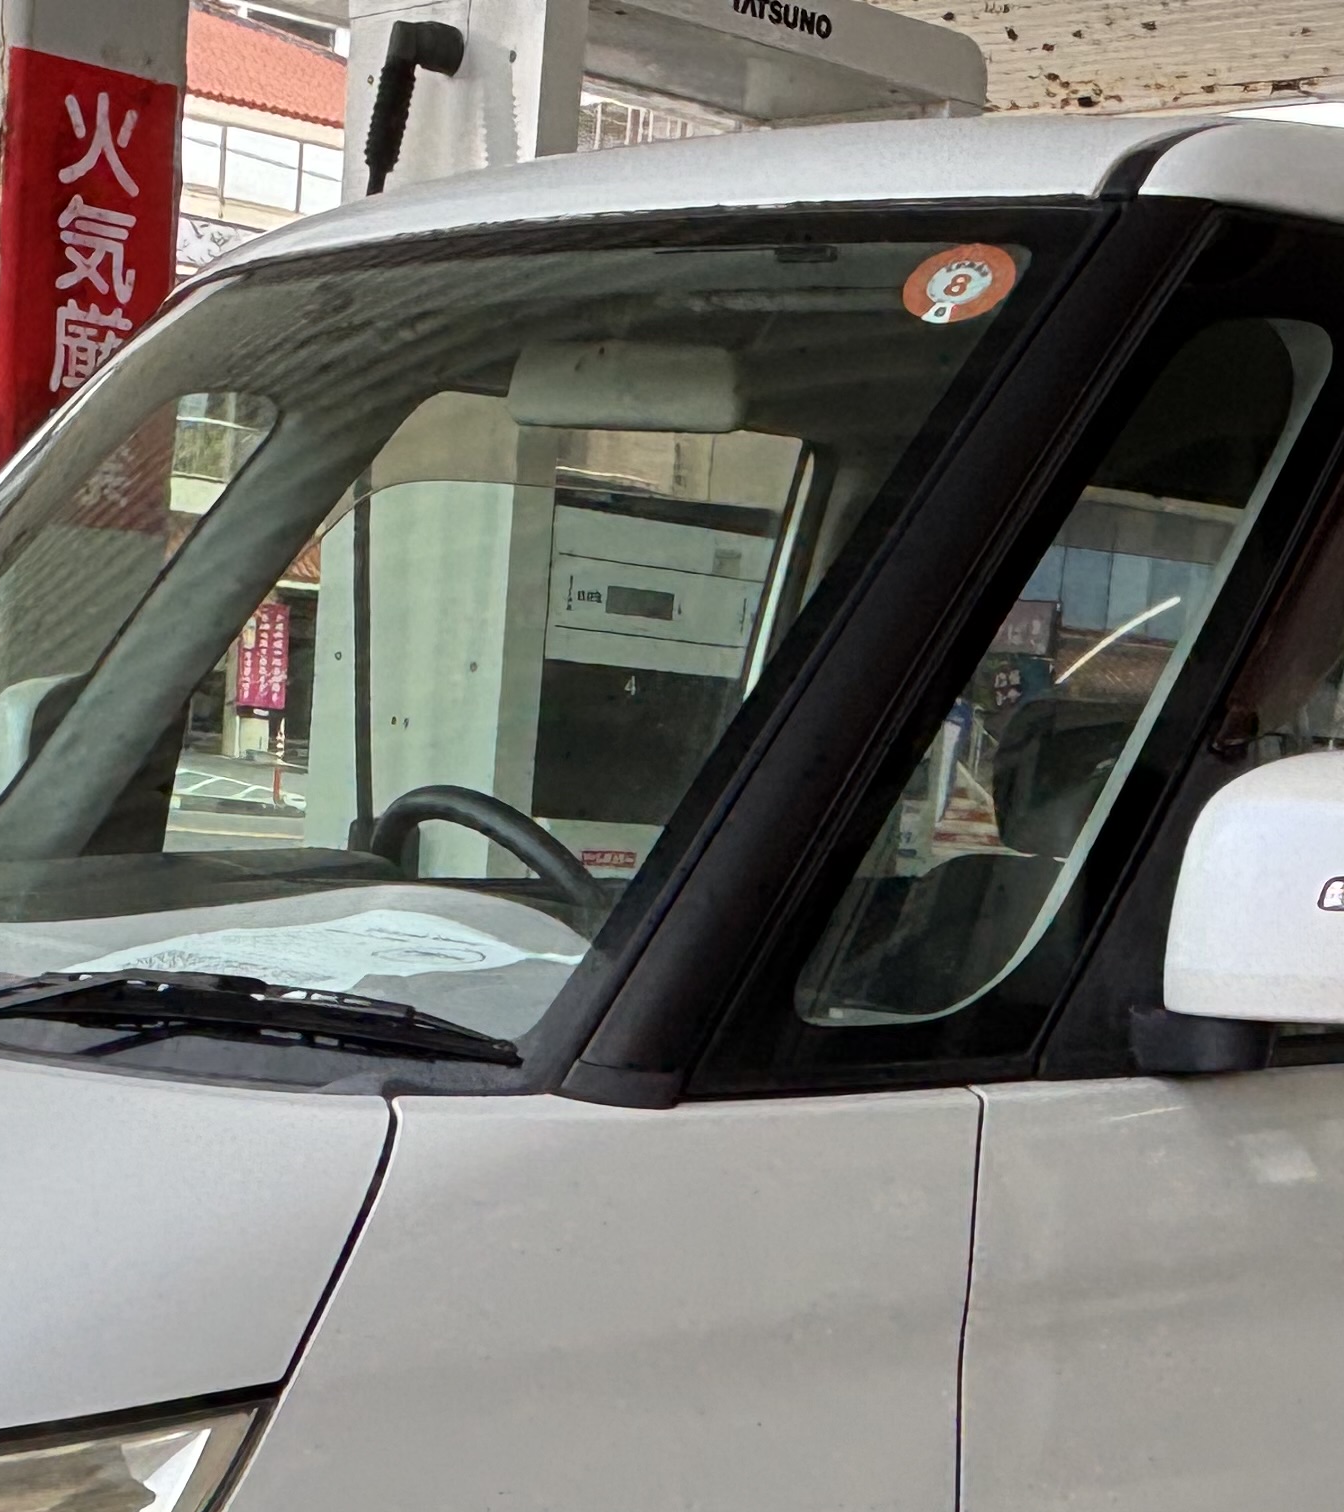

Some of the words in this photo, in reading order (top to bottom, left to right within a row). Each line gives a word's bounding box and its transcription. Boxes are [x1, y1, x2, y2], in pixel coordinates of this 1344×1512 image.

[50, 92, 139, 416] 火気厳
[625, 675, 636, 696] 4
